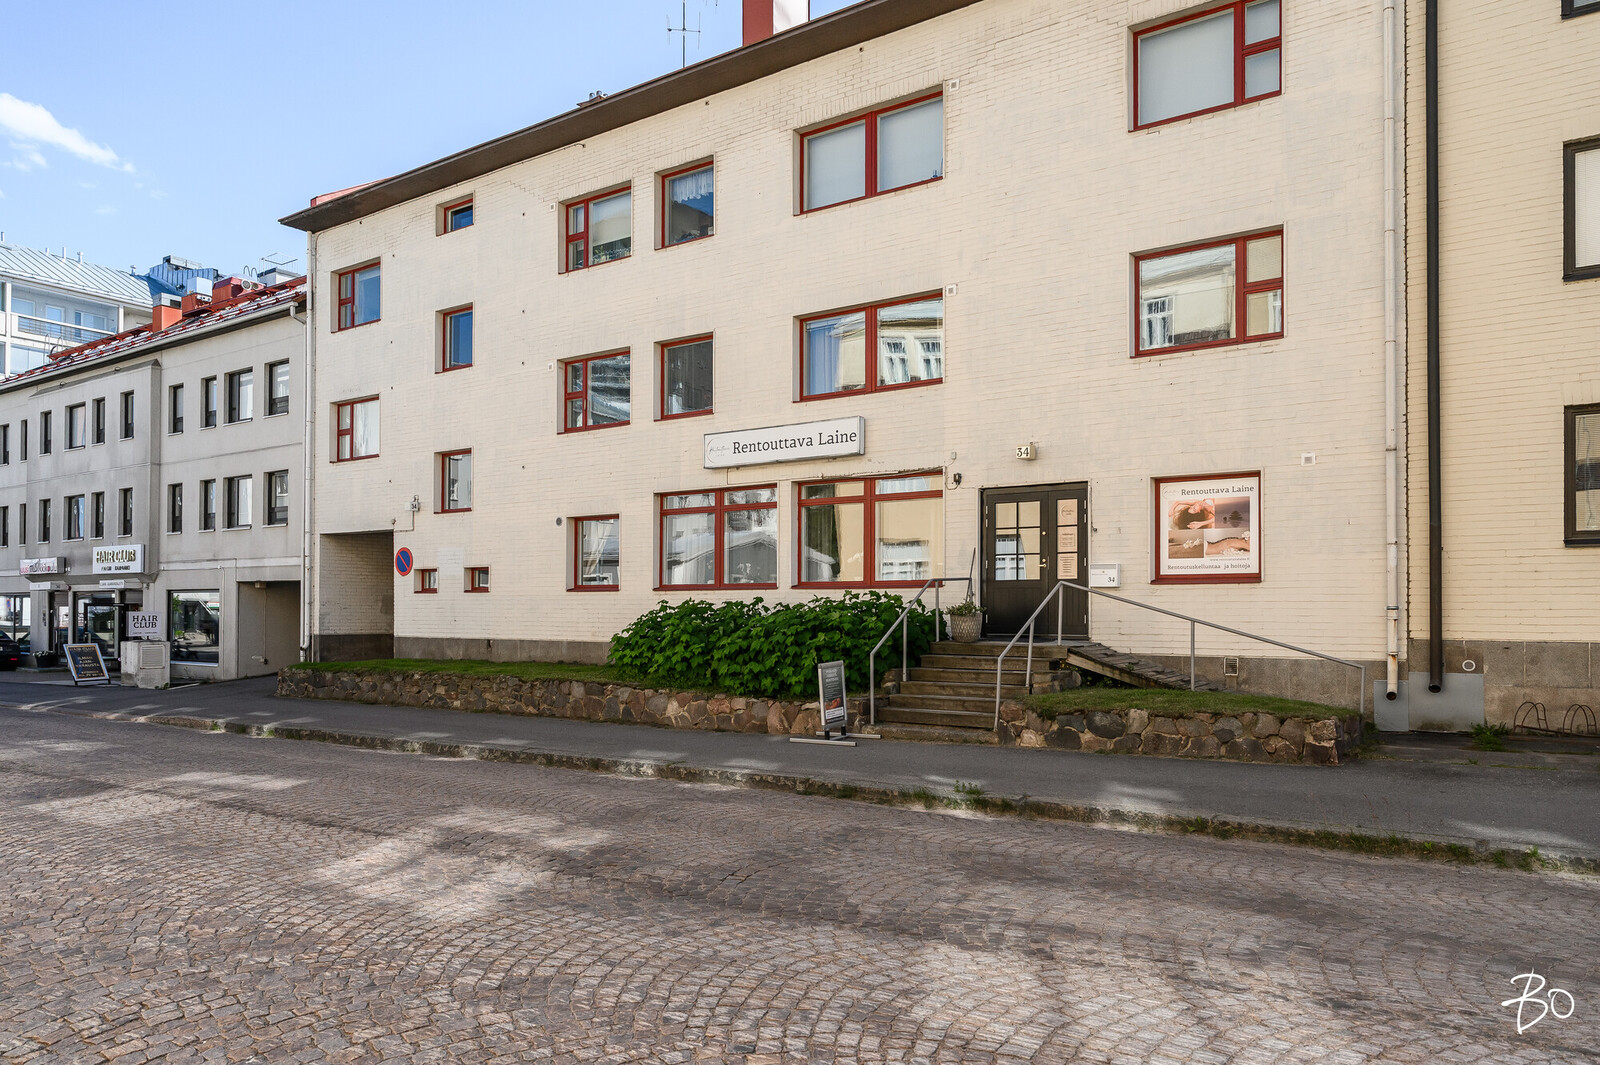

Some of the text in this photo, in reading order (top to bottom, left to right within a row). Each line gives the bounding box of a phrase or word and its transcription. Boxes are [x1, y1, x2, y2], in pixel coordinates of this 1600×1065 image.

[732, 436, 814, 454] Rentouttava
[818, 429, 857, 446] Laine
[1016, 447, 1030, 457] 34
[1181, 488, 1230, 496] Rentouttava
[1231, 485, 1255, 493] Laine
[96, 549, 136, 563] HAIR CLUB
[133, 621, 157, 629] CLUB
